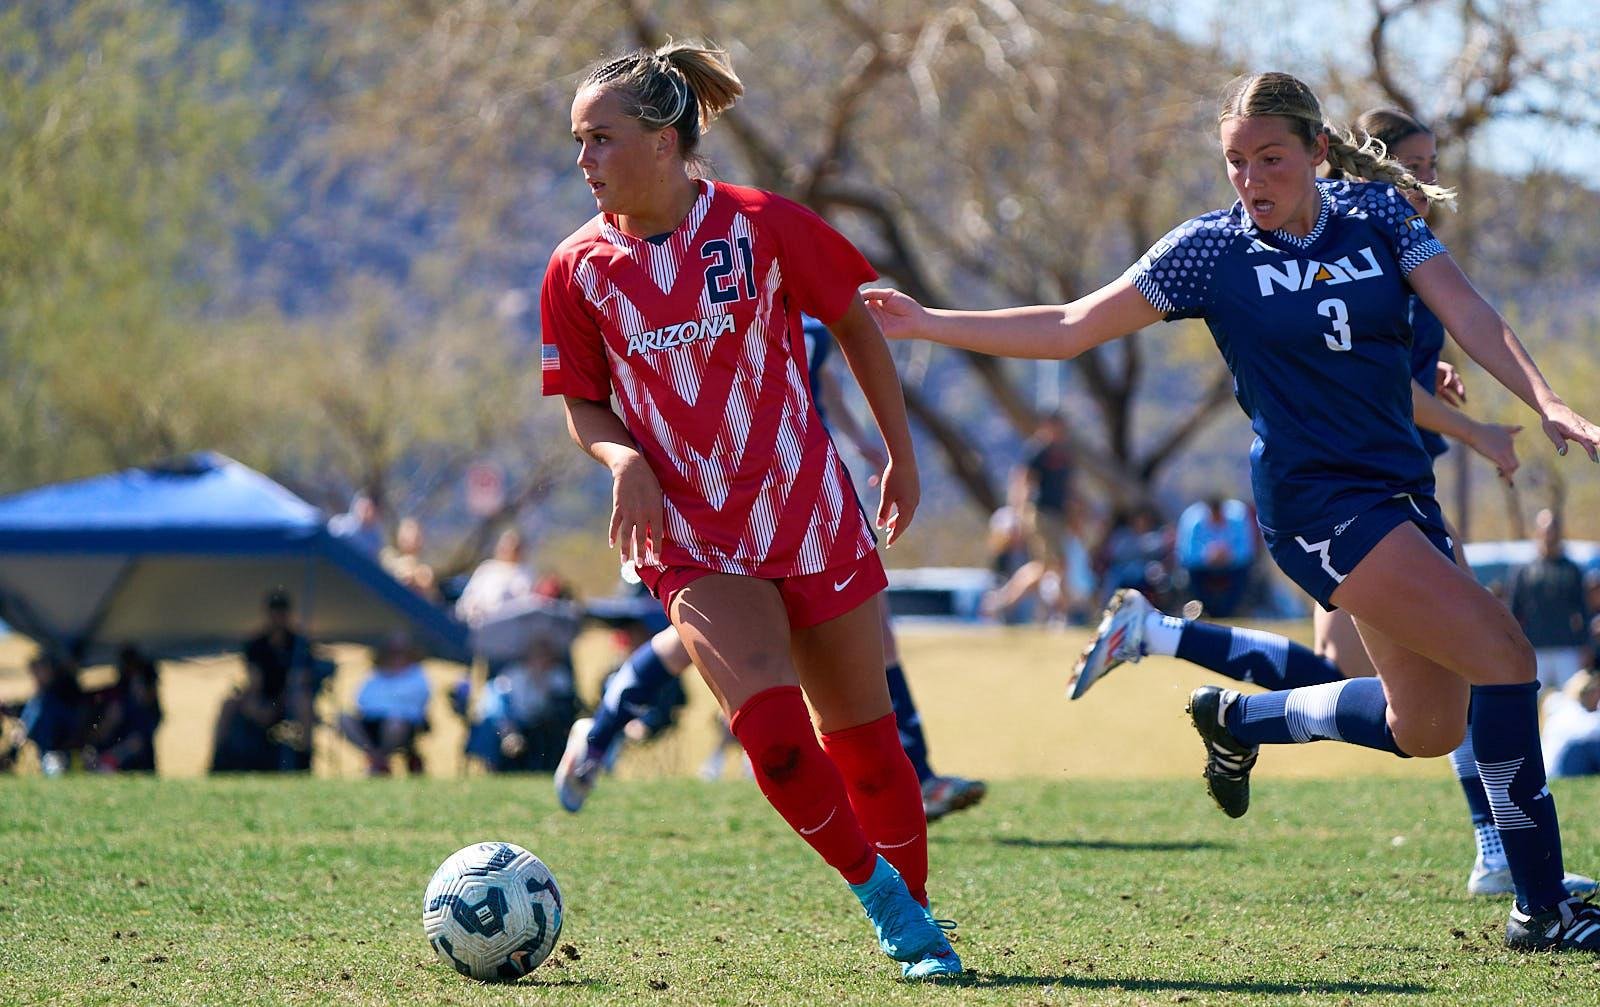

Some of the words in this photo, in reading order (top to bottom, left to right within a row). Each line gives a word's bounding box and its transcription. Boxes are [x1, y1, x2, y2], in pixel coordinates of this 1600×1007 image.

[700, 235, 757, 305] 21
[1253, 246, 1384, 297] NAU
[626, 313, 736, 357] ARIZONA
[1317, 297, 1352, 352] 3
